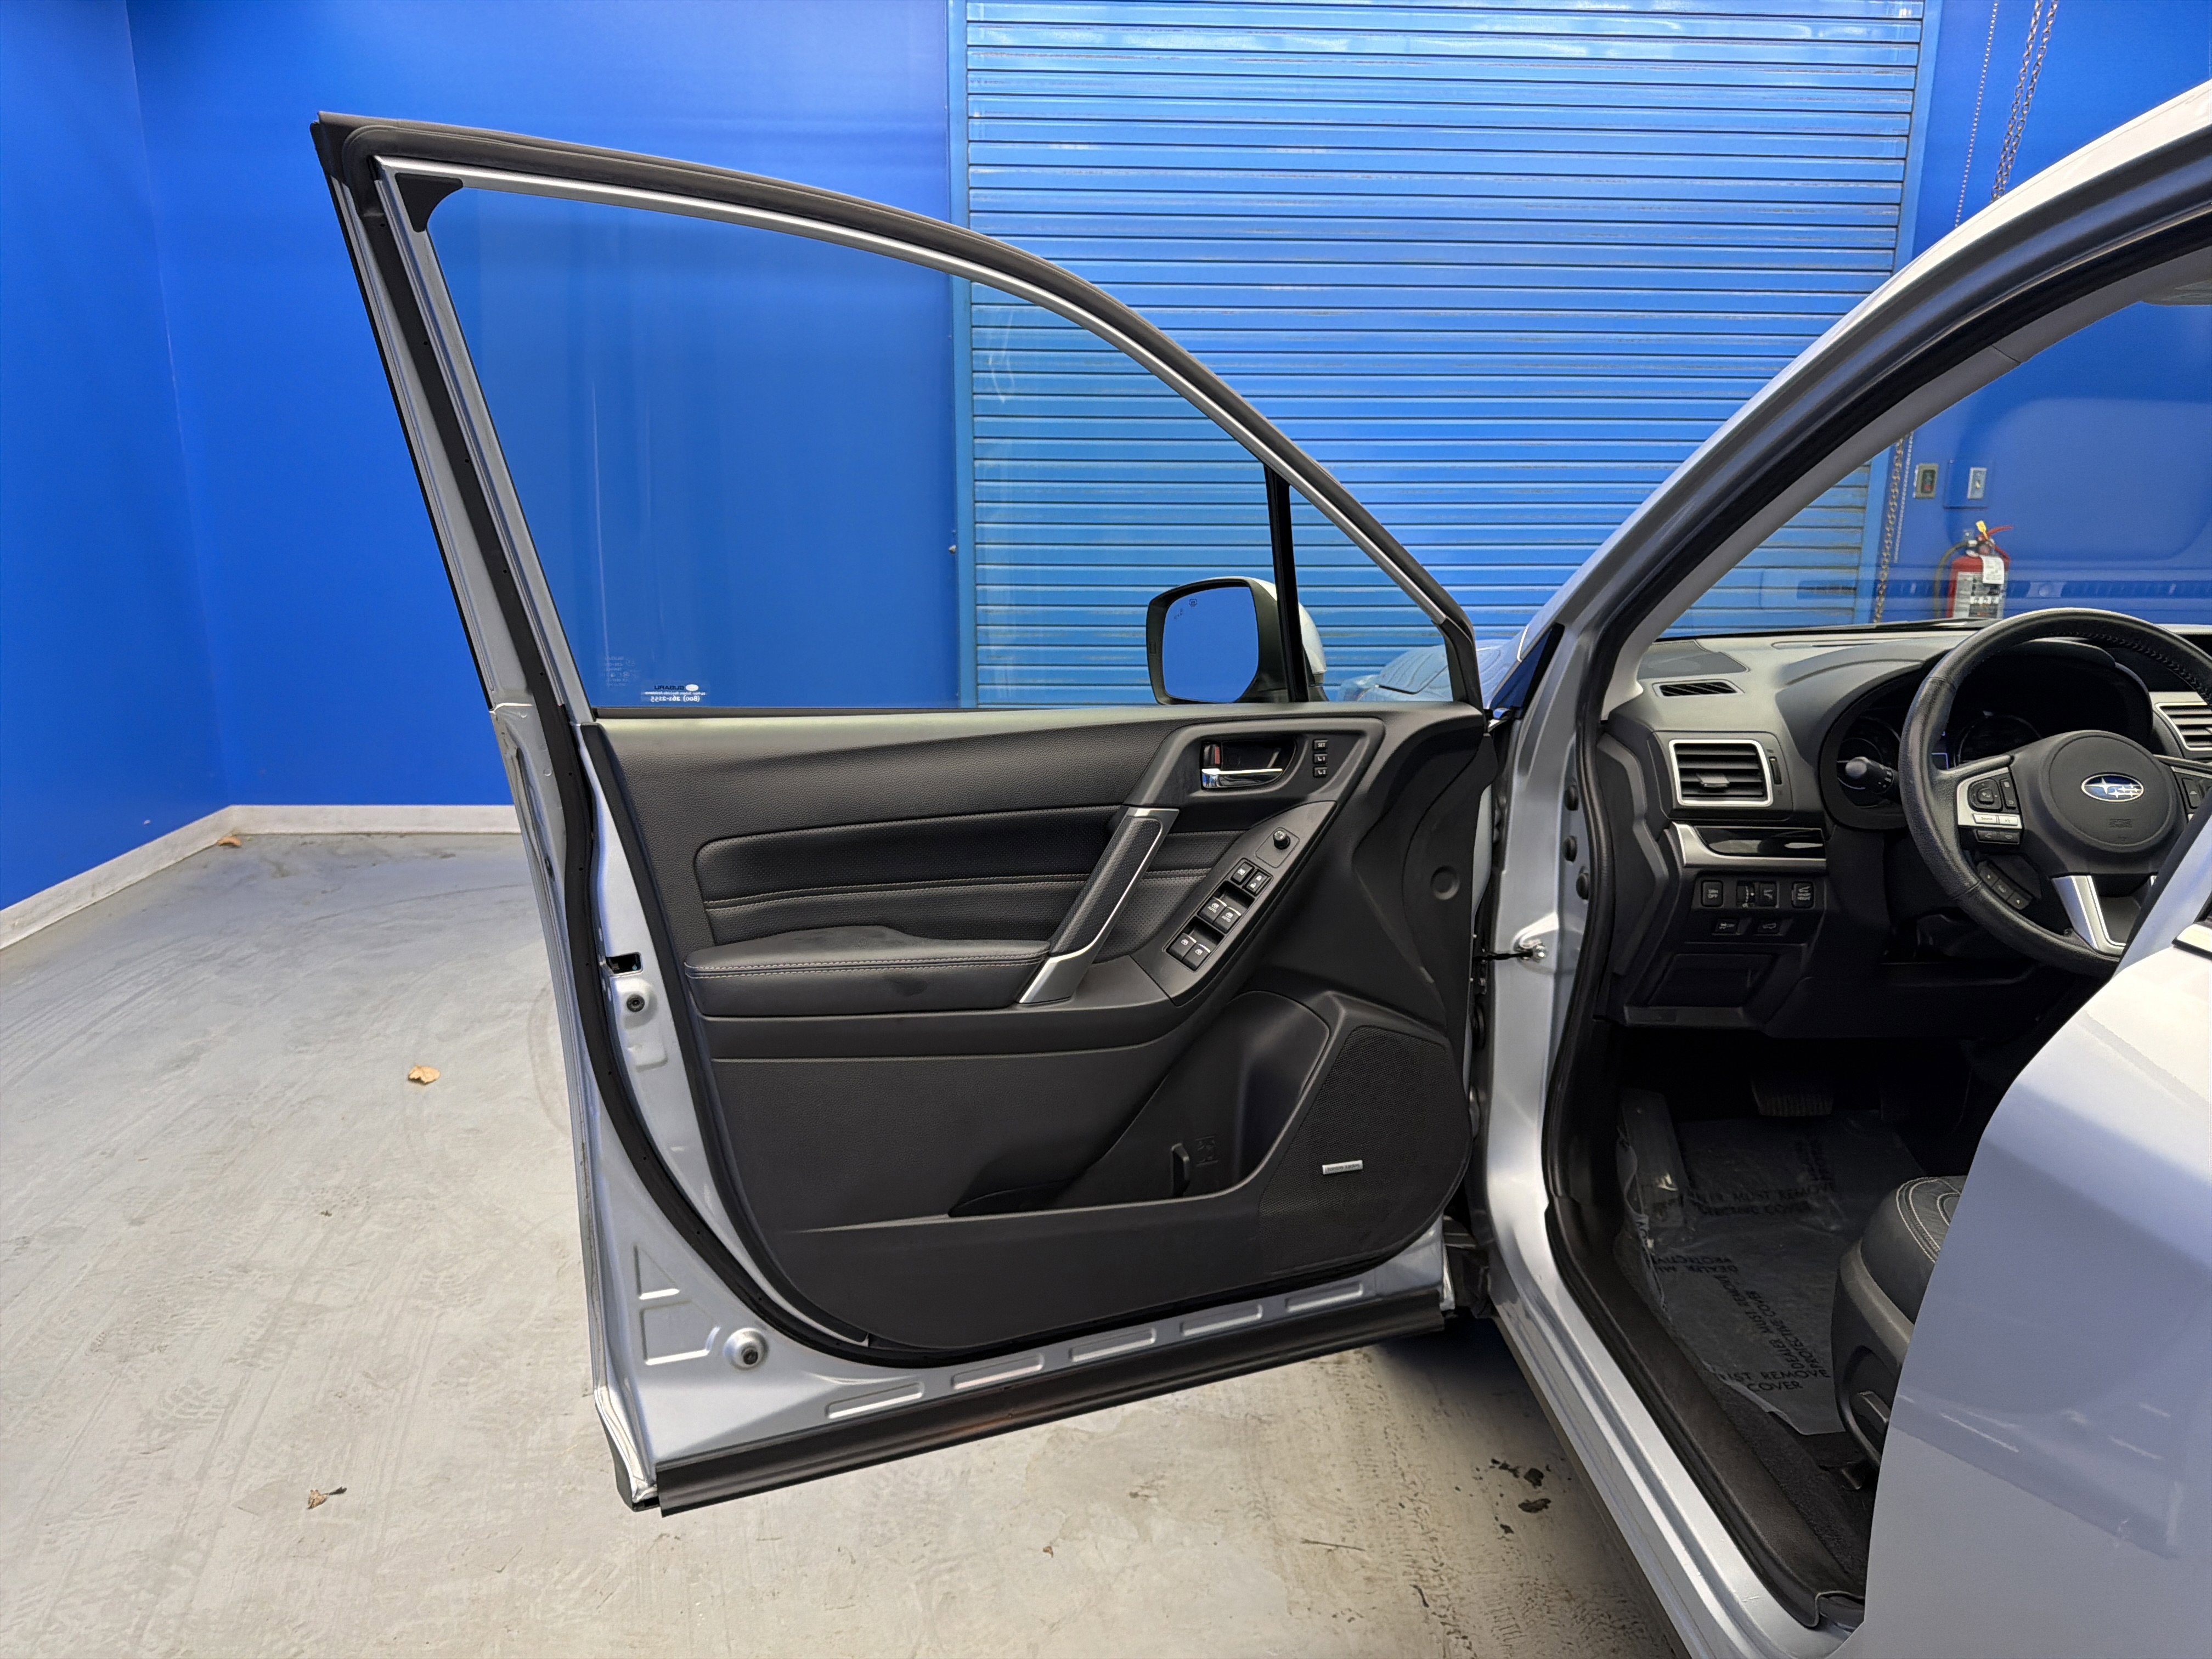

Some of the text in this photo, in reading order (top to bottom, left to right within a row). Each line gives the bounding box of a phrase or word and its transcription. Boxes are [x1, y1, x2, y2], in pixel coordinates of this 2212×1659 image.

[1769, 1339, 1805, 1369] DEALER
[1760, 1369, 1831, 1380] REMOVE
[1747, 1380, 1804, 1392] COVER
